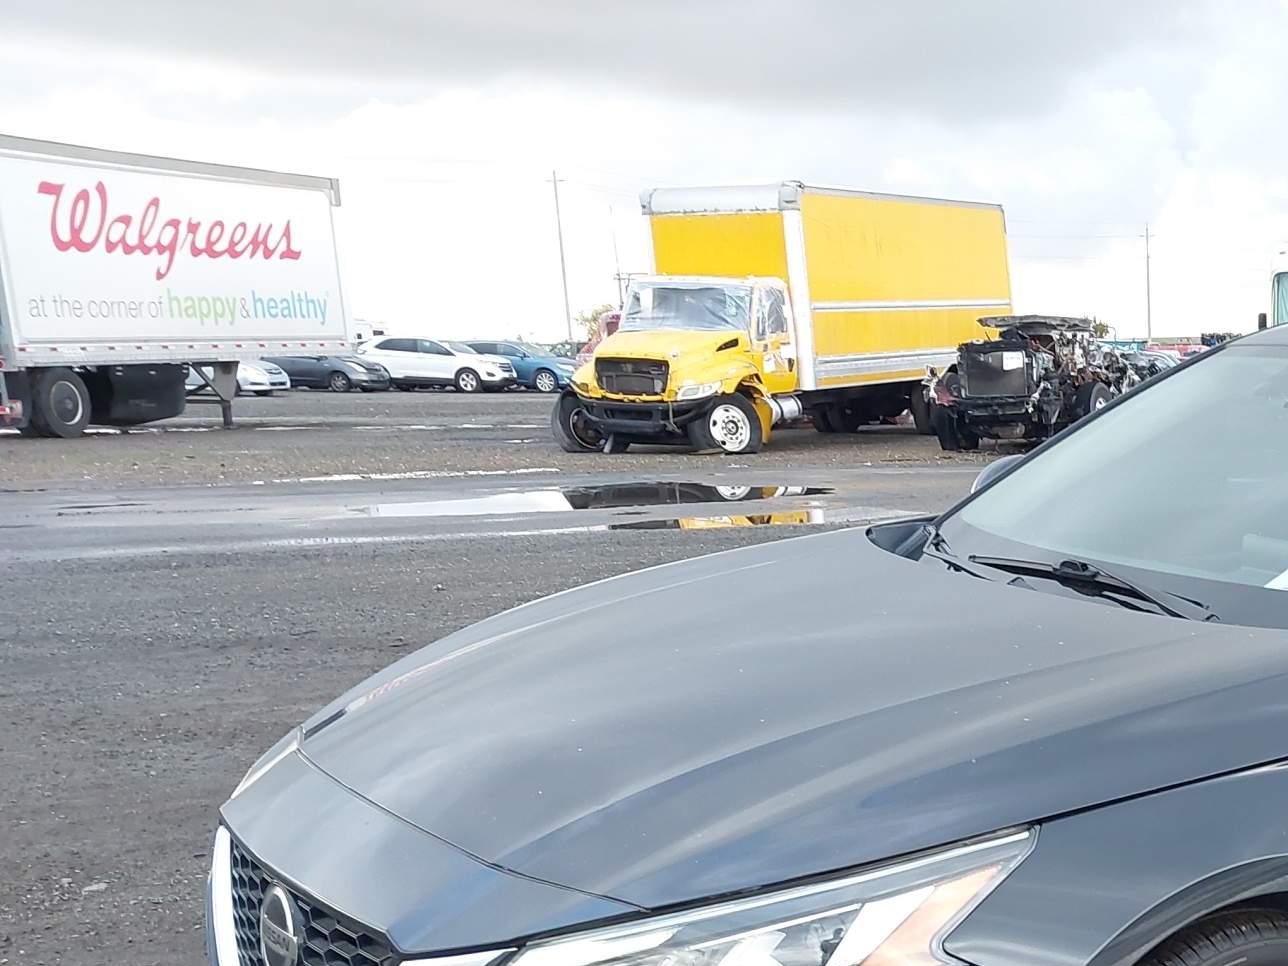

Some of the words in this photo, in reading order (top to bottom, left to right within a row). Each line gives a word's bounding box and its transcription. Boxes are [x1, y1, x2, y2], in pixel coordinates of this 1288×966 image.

[37, 181, 302, 281] Walgreens
[28, 295, 48, 318] at
[52, 294, 84, 319] the
[87, 299, 145, 319] corner
[148, 295, 163, 319] of
[166, 287, 237, 326] happy
[240, 297, 251, 319] &
[251, 289, 328, 326] healthy
